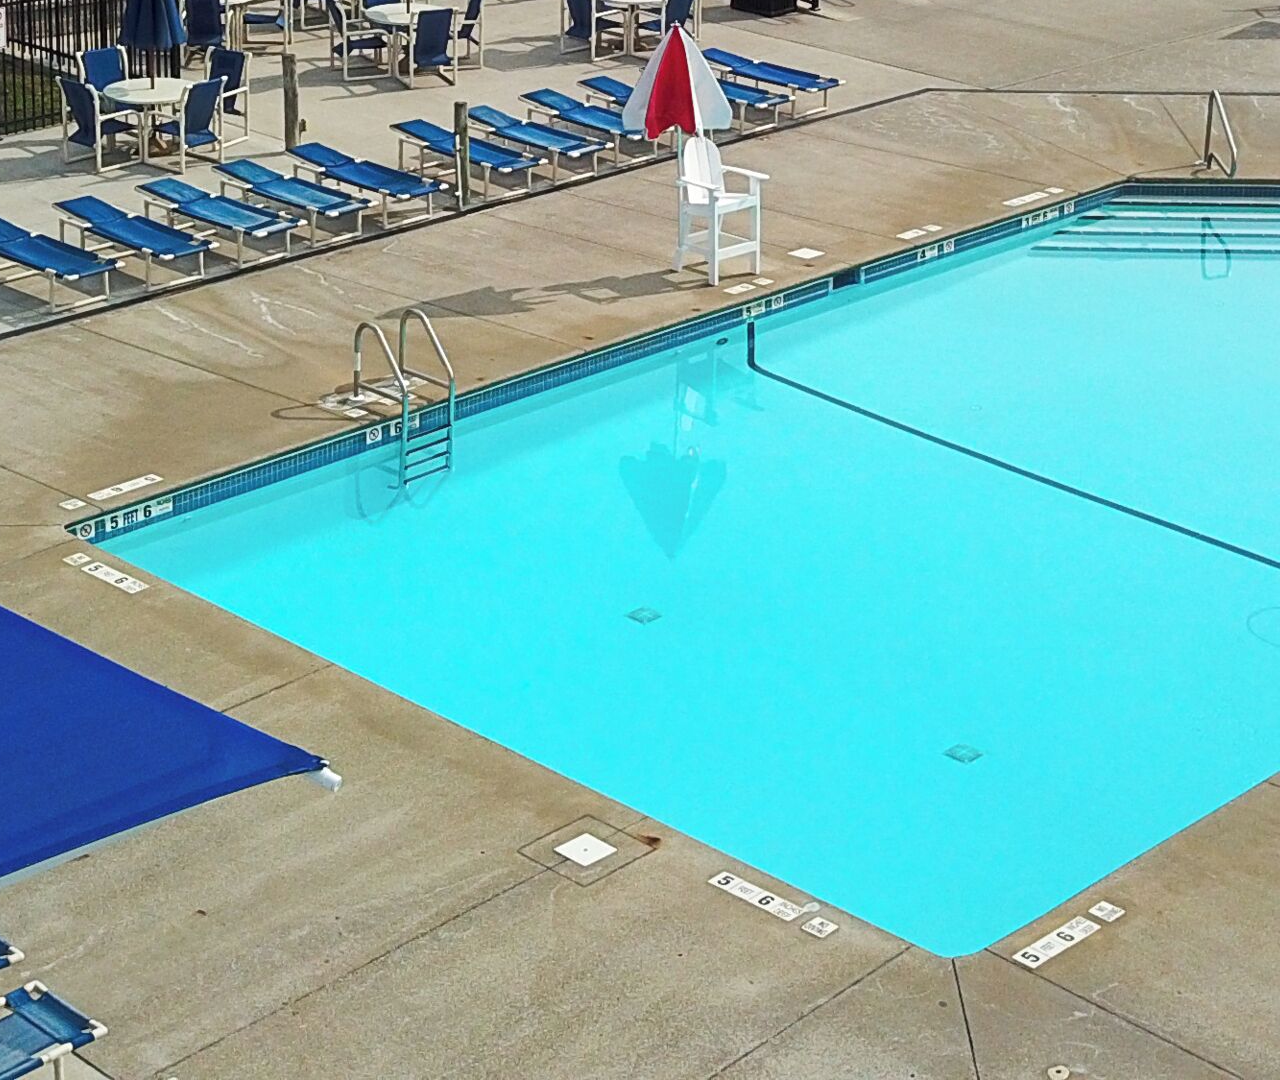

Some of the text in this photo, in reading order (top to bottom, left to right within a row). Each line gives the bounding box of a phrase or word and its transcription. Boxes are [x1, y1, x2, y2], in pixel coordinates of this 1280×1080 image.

[110, 515, 119, 530] 5
[122, 508, 139, 527] FEET
[143, 504, 152, 518] 6
[88, 564, 128, 585] 5 6
[717, 875, 734, 886] 5
[758, 895, 775, 906] 6
[1021, 951, 1040, 963] 5
[1056, 931, 1075, 942] 6
